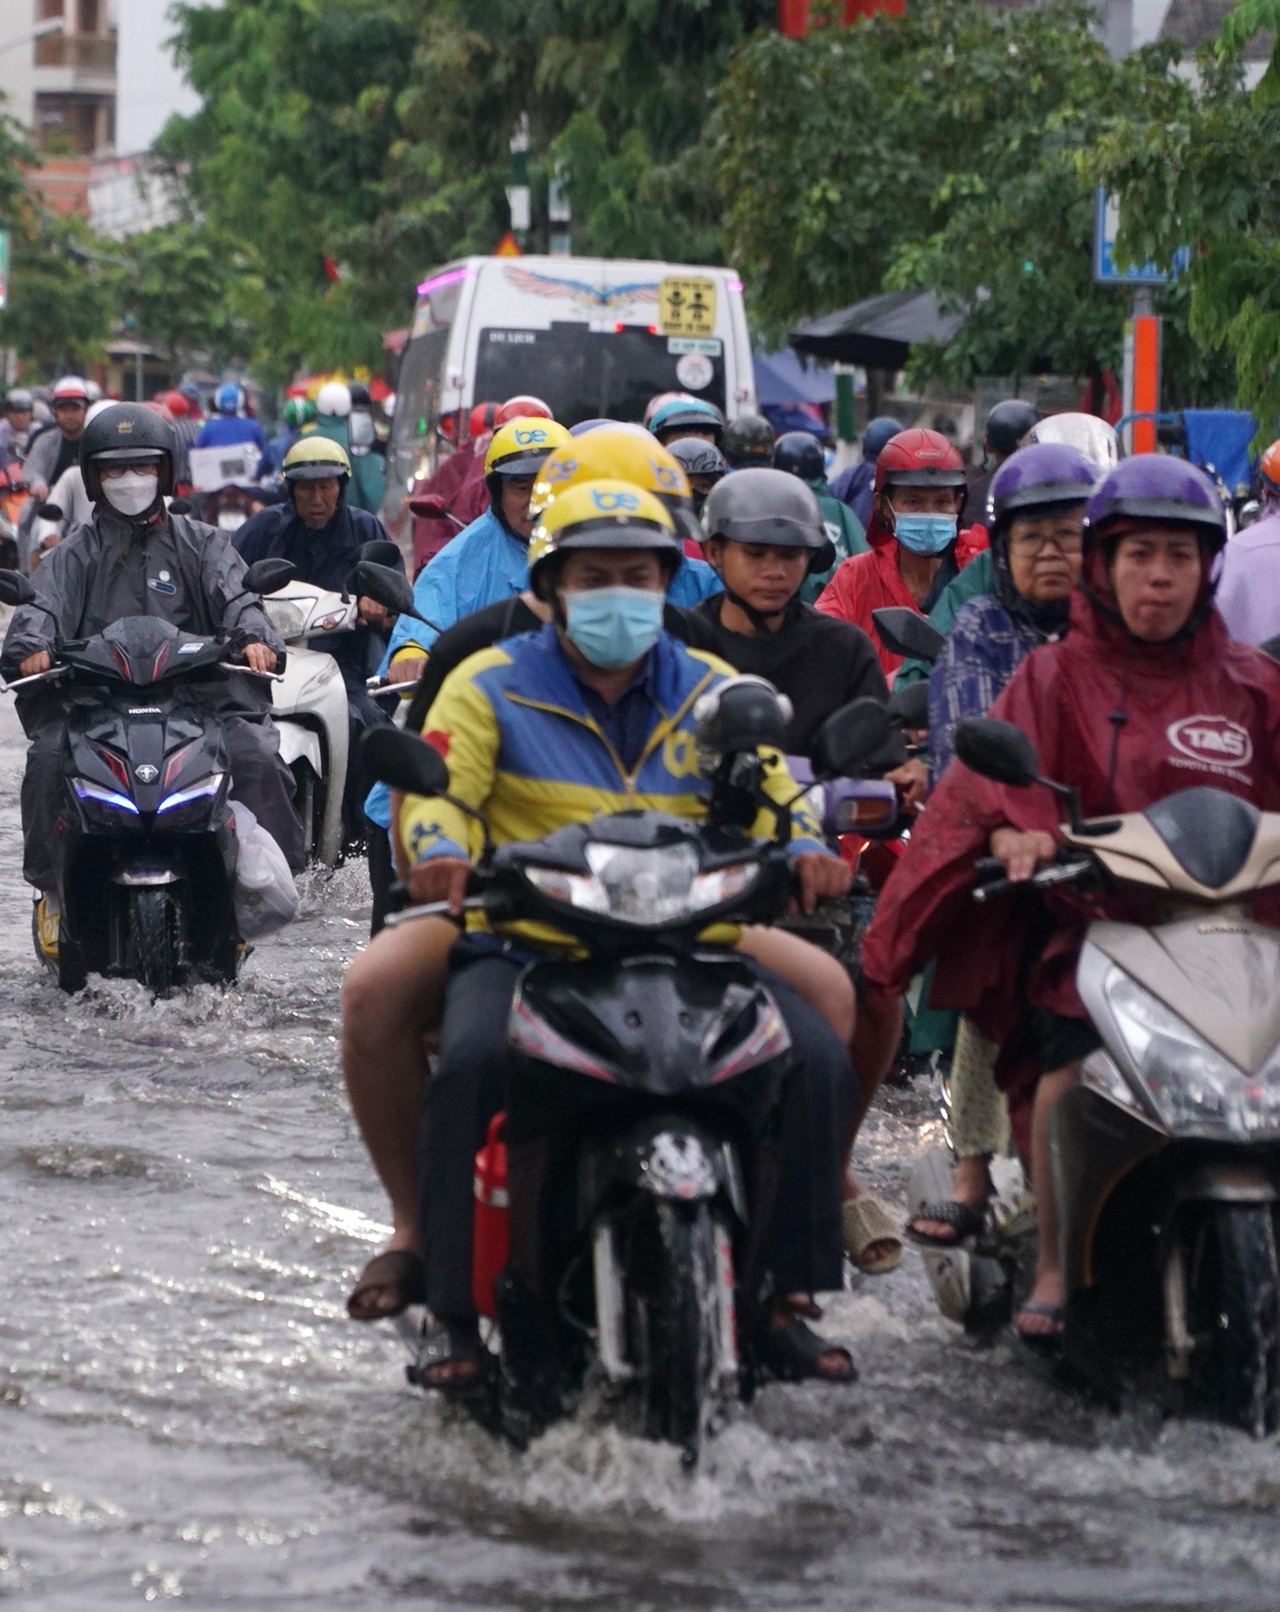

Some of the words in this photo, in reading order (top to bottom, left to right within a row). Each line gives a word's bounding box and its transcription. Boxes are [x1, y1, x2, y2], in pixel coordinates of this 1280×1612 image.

[514, 428, 548, 446] be
[590, 486, 642, 512] be
[1182, 727, 1245, 757] TAS
